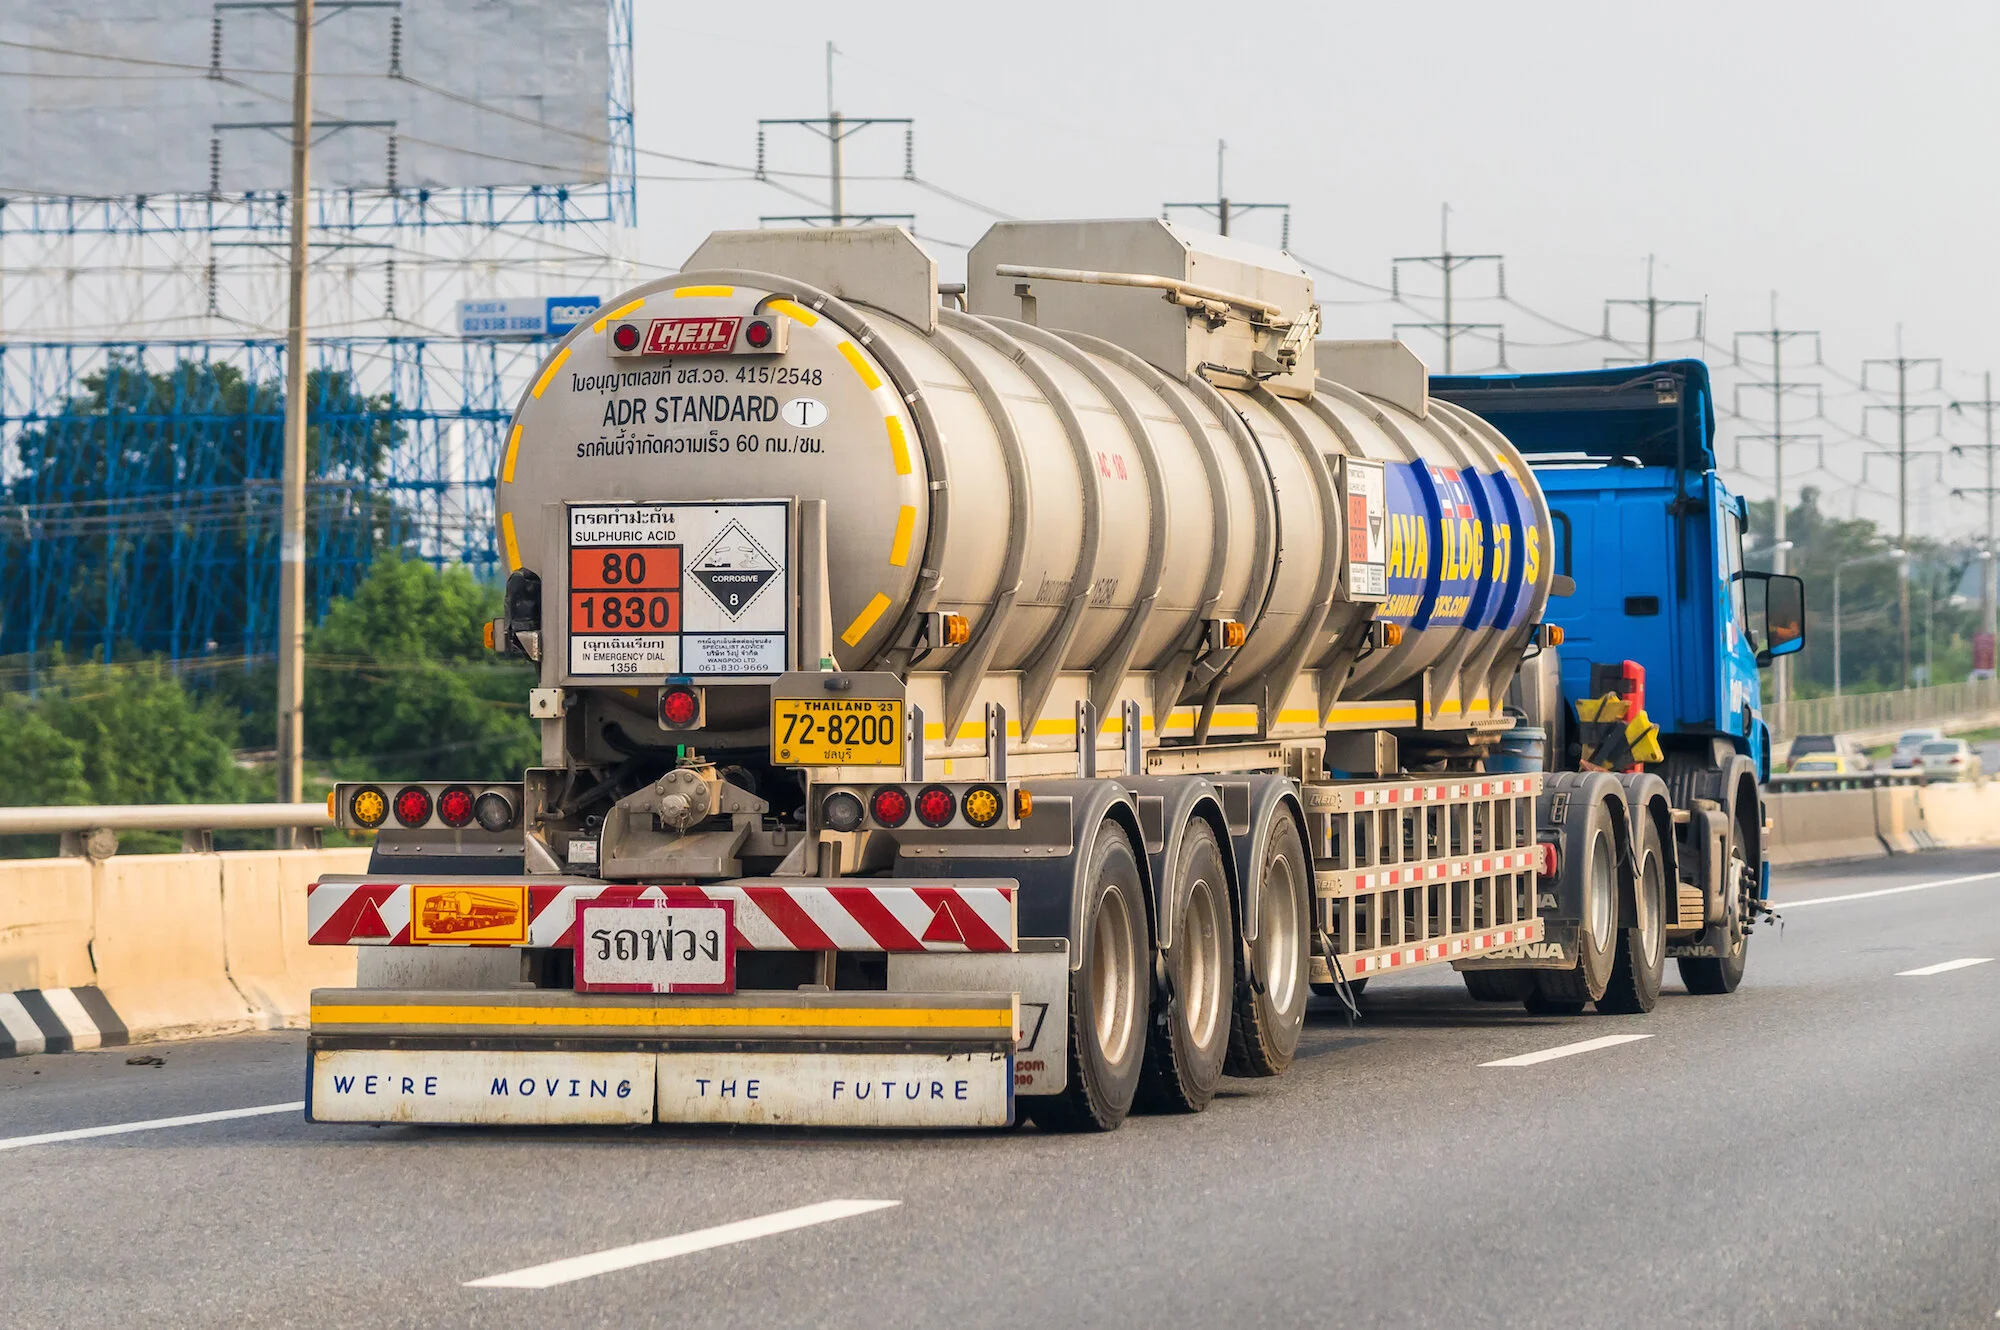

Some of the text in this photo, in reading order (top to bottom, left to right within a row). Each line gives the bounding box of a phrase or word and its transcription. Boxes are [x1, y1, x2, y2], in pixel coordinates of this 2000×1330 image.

[658, 322, 727, 343] HEIL
[661, 343, 715, 351] TRAILER
[735, 366, 822, 386] 415/2548
[602, 395, 814, 427] ADR STANDARD T
[736, 434, 759, 453] 60
[765, 436, 825, 454] กม./ชม.
[574, 507, 676, 525] กรดกำมะถัน
[575, 530, 676, 542] SULPHURIC ACID
[601, 553, 646, 585] 80
[711, 574, 759, 583] CORROSIVE
[729, 593, 739, 606] 8
[580, 597, 669, 629] 1830
[582, 652, 665, 661] IN EMERGENCY DIAL
[610, 662, 638, 673] 1356
[698, 664, 769, 672] 061-830-9669
[804, 702, 893, 711] THAILAND 23
[783, 714, 894, 745] 72-8200
[824, 748, 852, 763] ชลบุรี
[591, 916, 719, 962] รถพ่วง
[334, 1074, 969, 1100] WE'RE MOVING THE FUTURE
